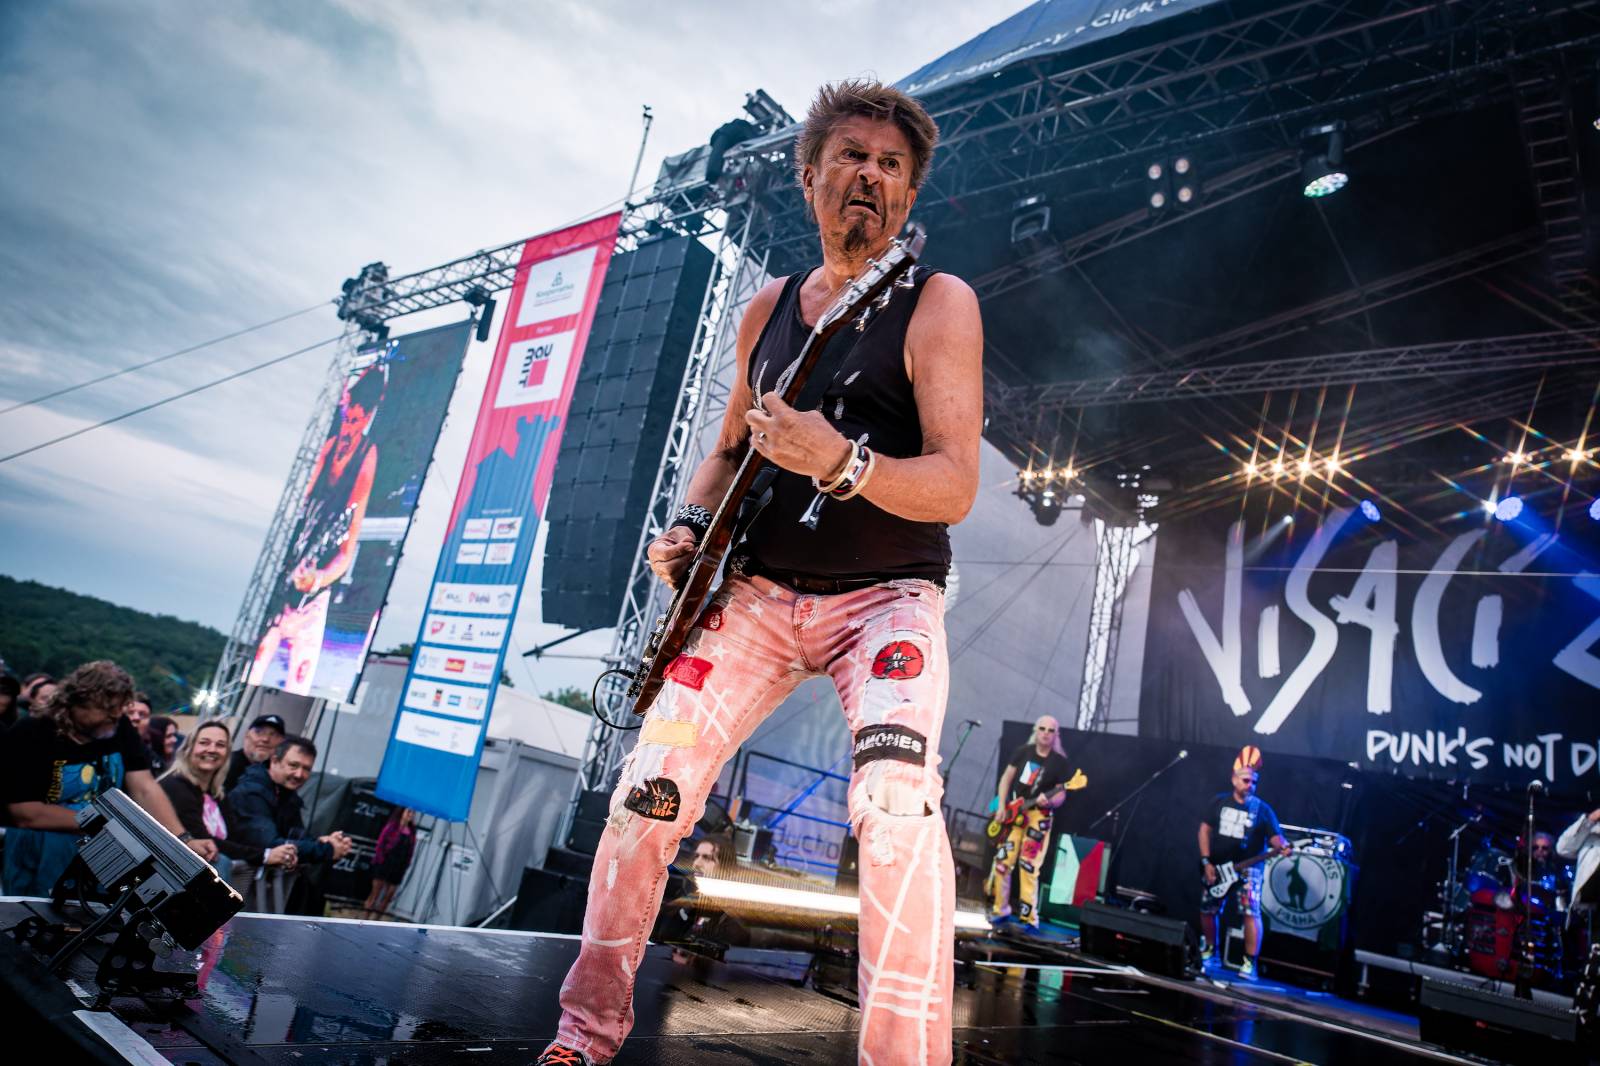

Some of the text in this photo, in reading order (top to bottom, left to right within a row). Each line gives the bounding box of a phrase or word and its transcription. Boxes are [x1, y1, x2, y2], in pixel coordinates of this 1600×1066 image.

[1091, 1, 1153, 27] Click
[1366, 726, 1495, 771] PUNK'S
[1503, 733, 1563, 783] NOT
